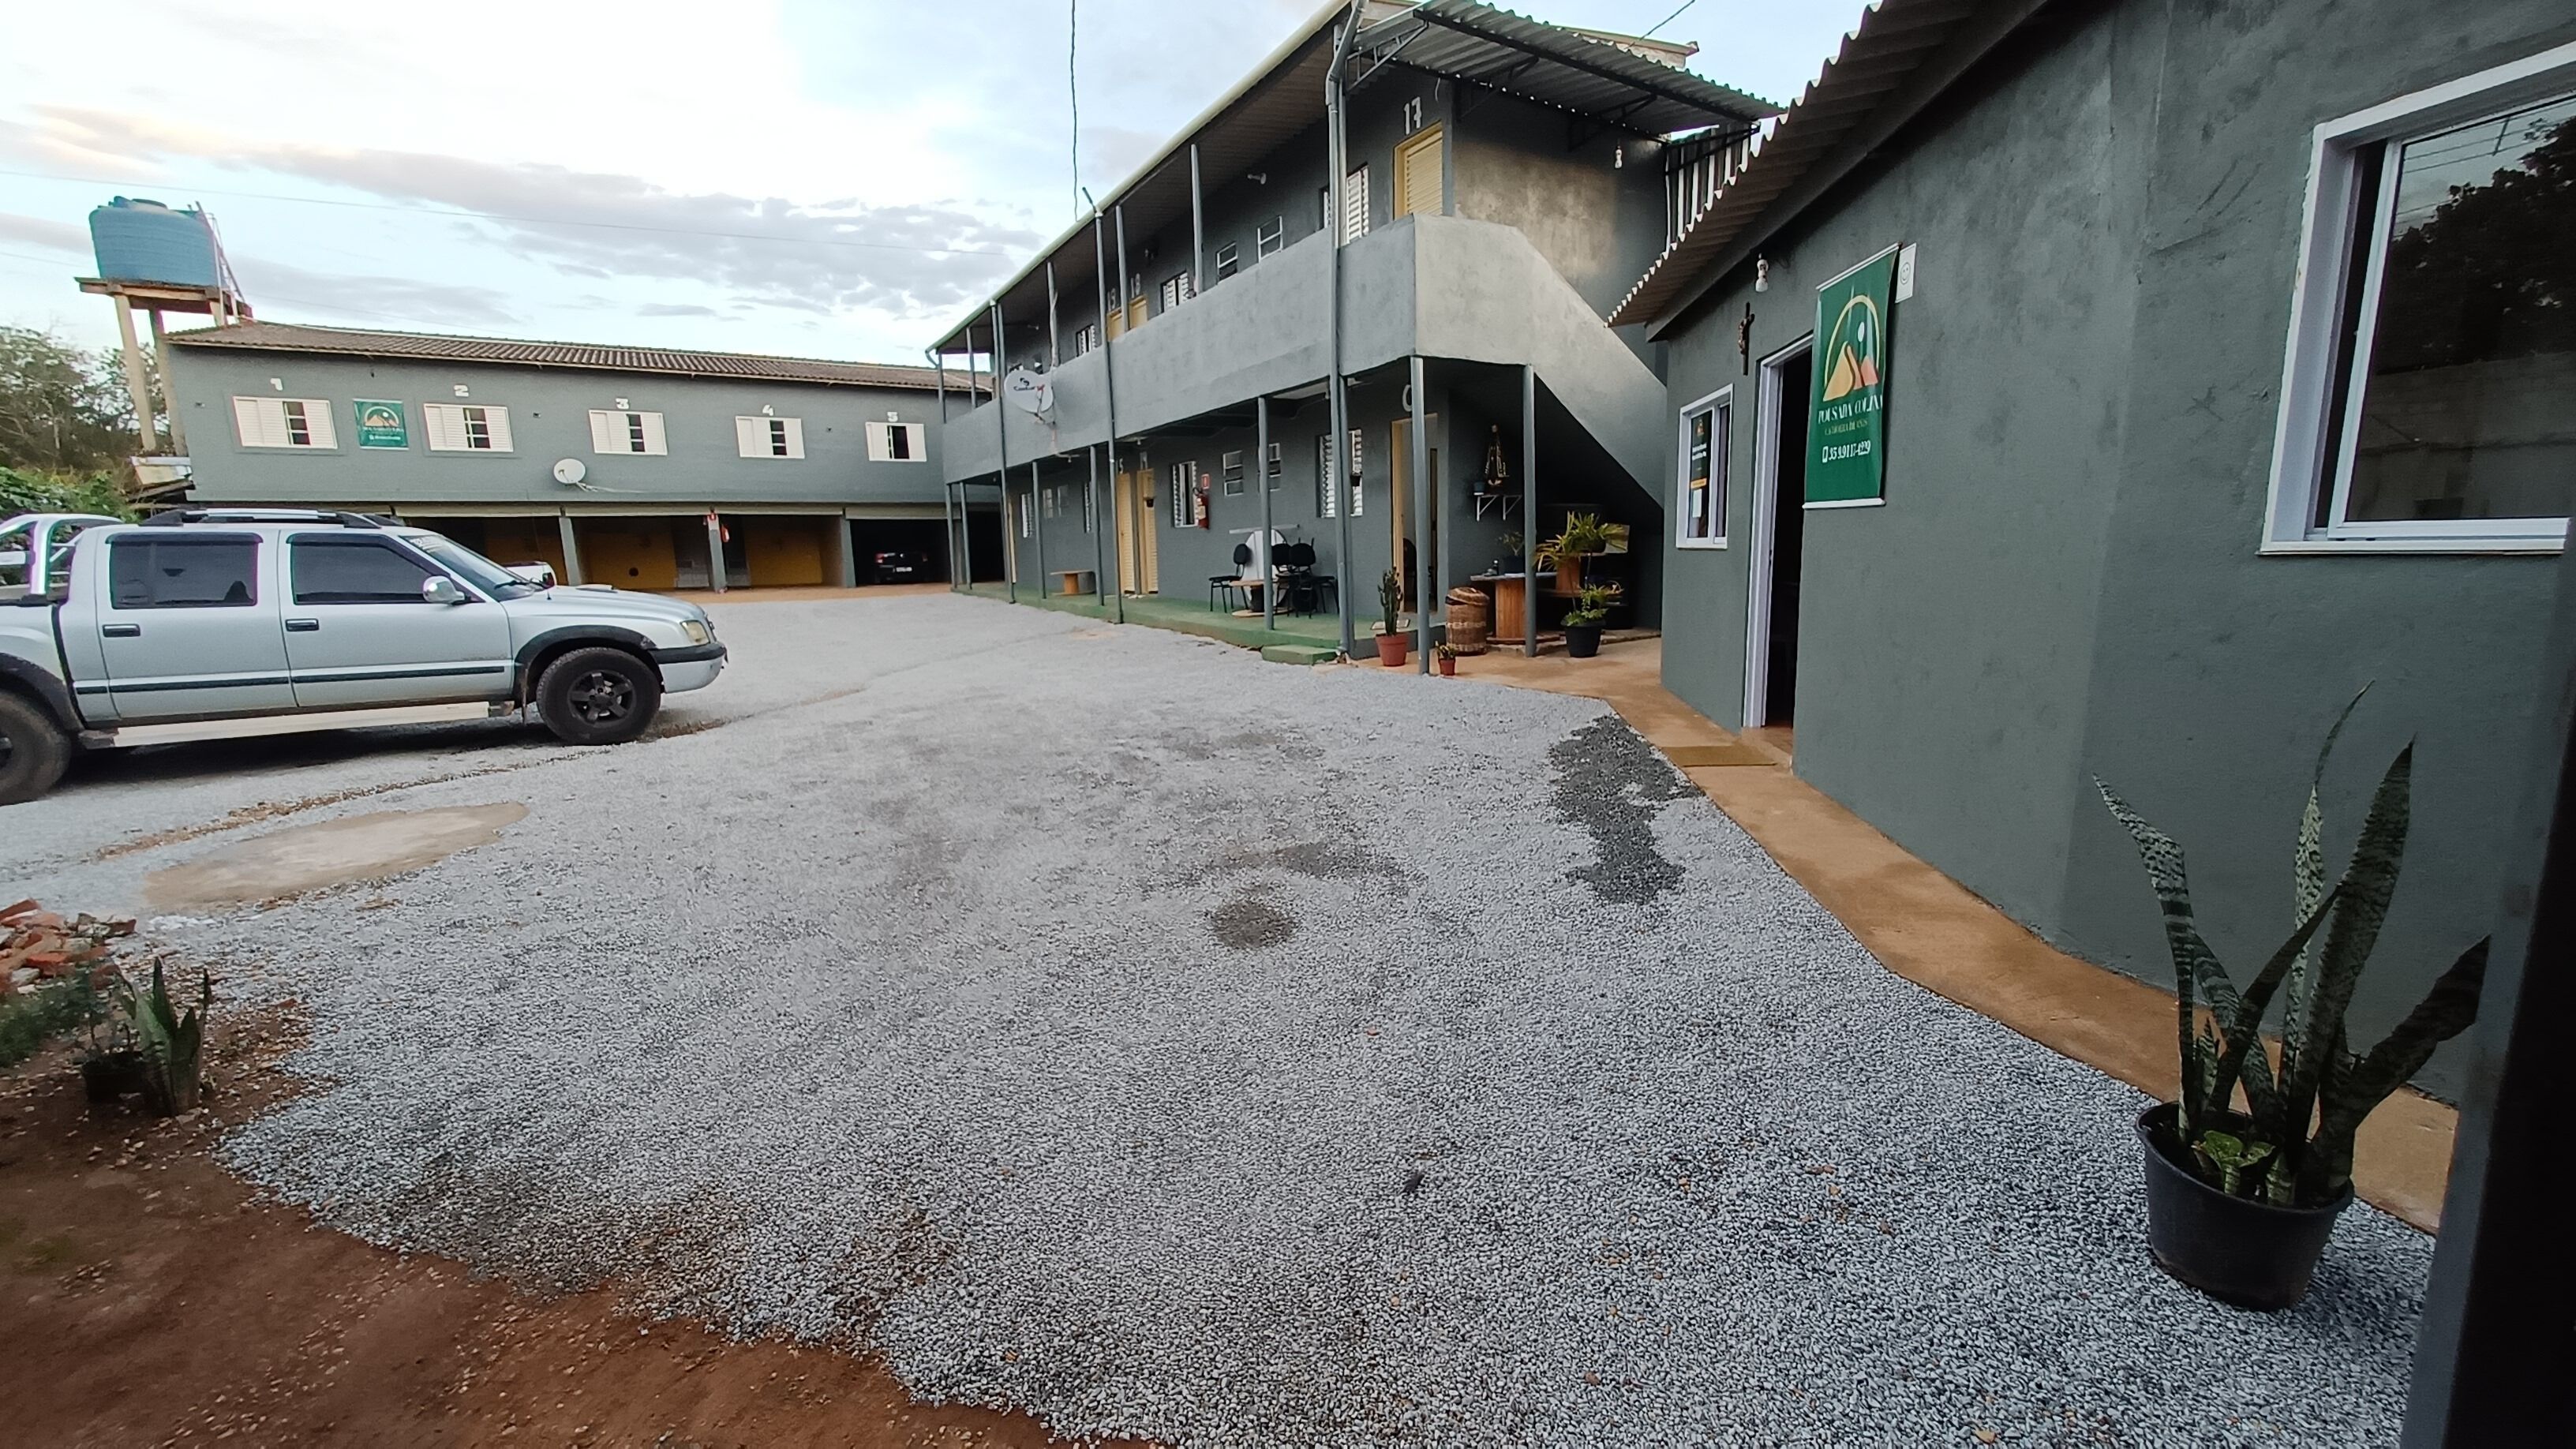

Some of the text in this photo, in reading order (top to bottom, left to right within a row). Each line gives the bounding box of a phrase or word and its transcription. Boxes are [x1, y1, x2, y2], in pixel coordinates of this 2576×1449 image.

[1404, 96, 1422, 135] 17
[270, 377, 283, 391] 1
[454, 384, 470, 397] 2
[616, 398, 629, 410] 3
[762, 404, 774, 416] 4
[887, 411, 898, 422] 5
